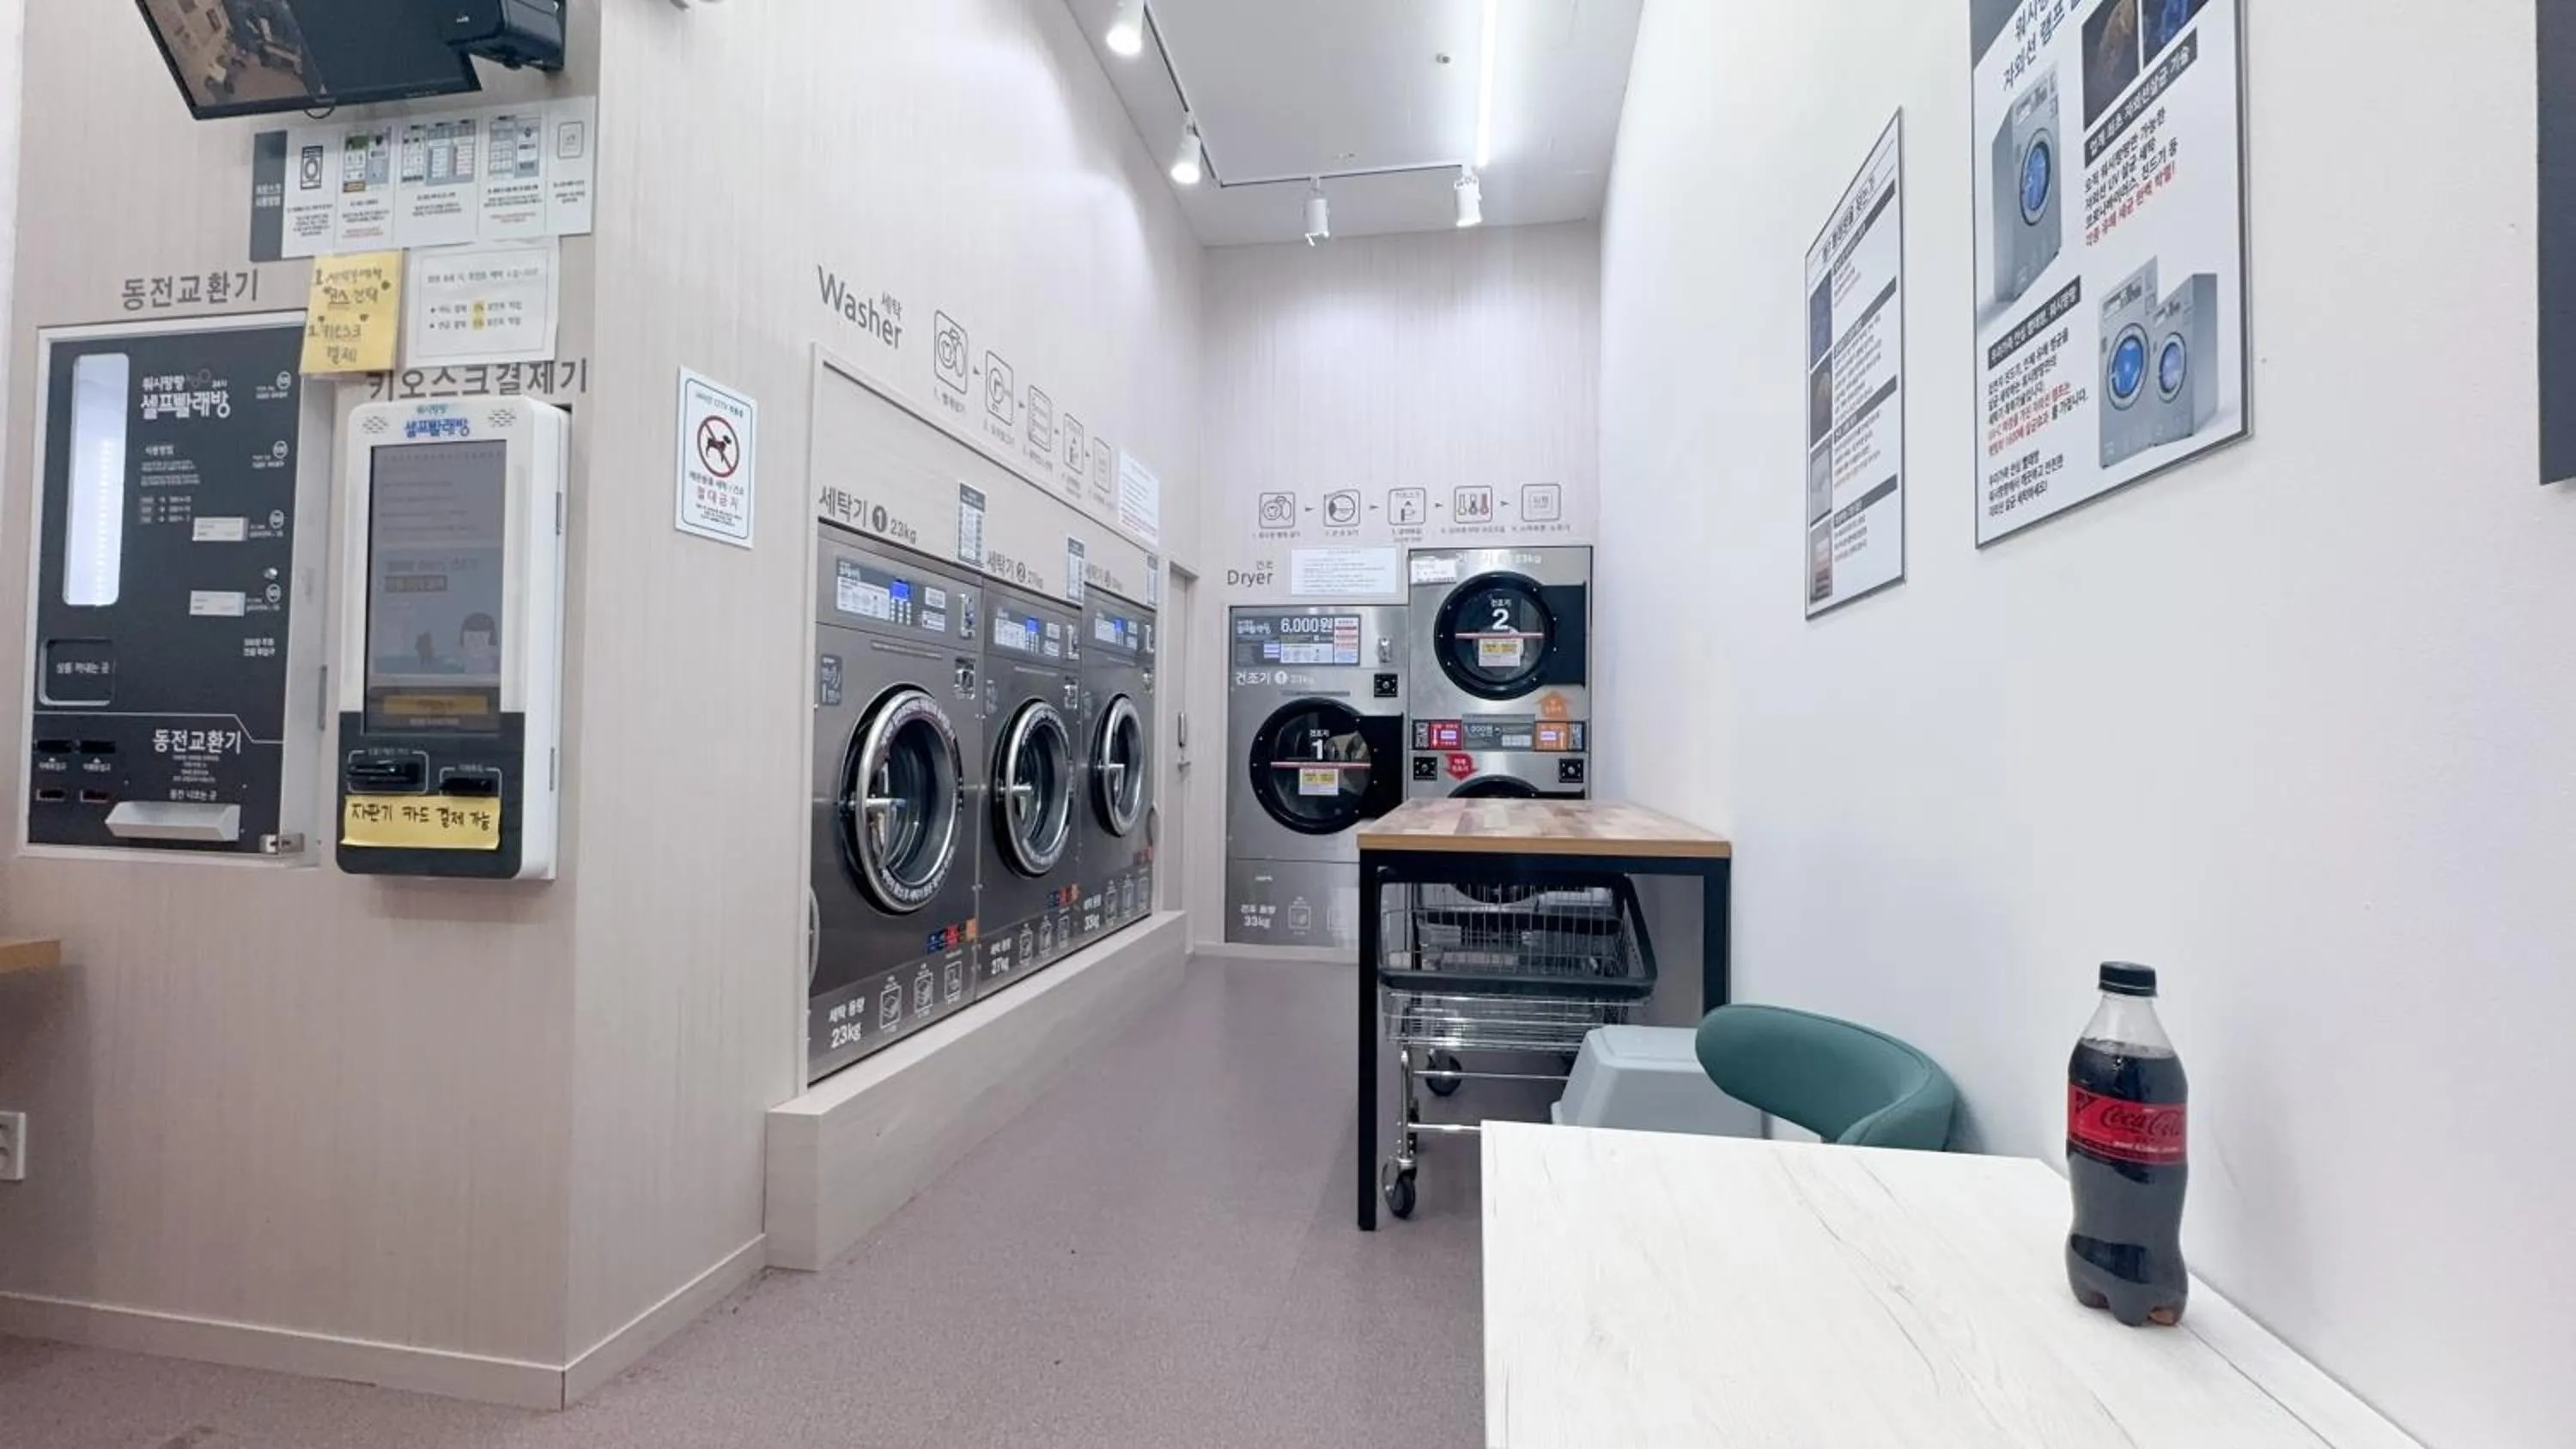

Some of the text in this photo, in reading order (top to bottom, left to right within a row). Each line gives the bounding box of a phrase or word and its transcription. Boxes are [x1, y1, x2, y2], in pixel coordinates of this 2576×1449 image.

[2003, 32, 2036, 91] 자외선
[122, 269, 258, 311] 동전교환기
[817, 265, 902, 349] Washer
[881, 292, 902, 320] 세탁
[365, 358, 588, 401] 키오스크결제기
[140, 391, 231, 420] 셀프빨래방
[404, 417, 471, 439] 셀프빨래방
[819, 486, 866, 528] 세탁기
[890, 518, 917, 544] 23kg
[987, 550, 1014, 580] 세탁기
[1227, 569, 1274, 588] Dryer
[1492, 608, 1509, 630] 2
[1236, 670, 1270, 685] 건조기
[151, 729, 241, 755] 동전교환기
[1311, 739, 1324, 760] 1
[351, 803, 490, 831] 자판기 카드 결제 가능
[830, 1022, 862, 1049] 23kg
